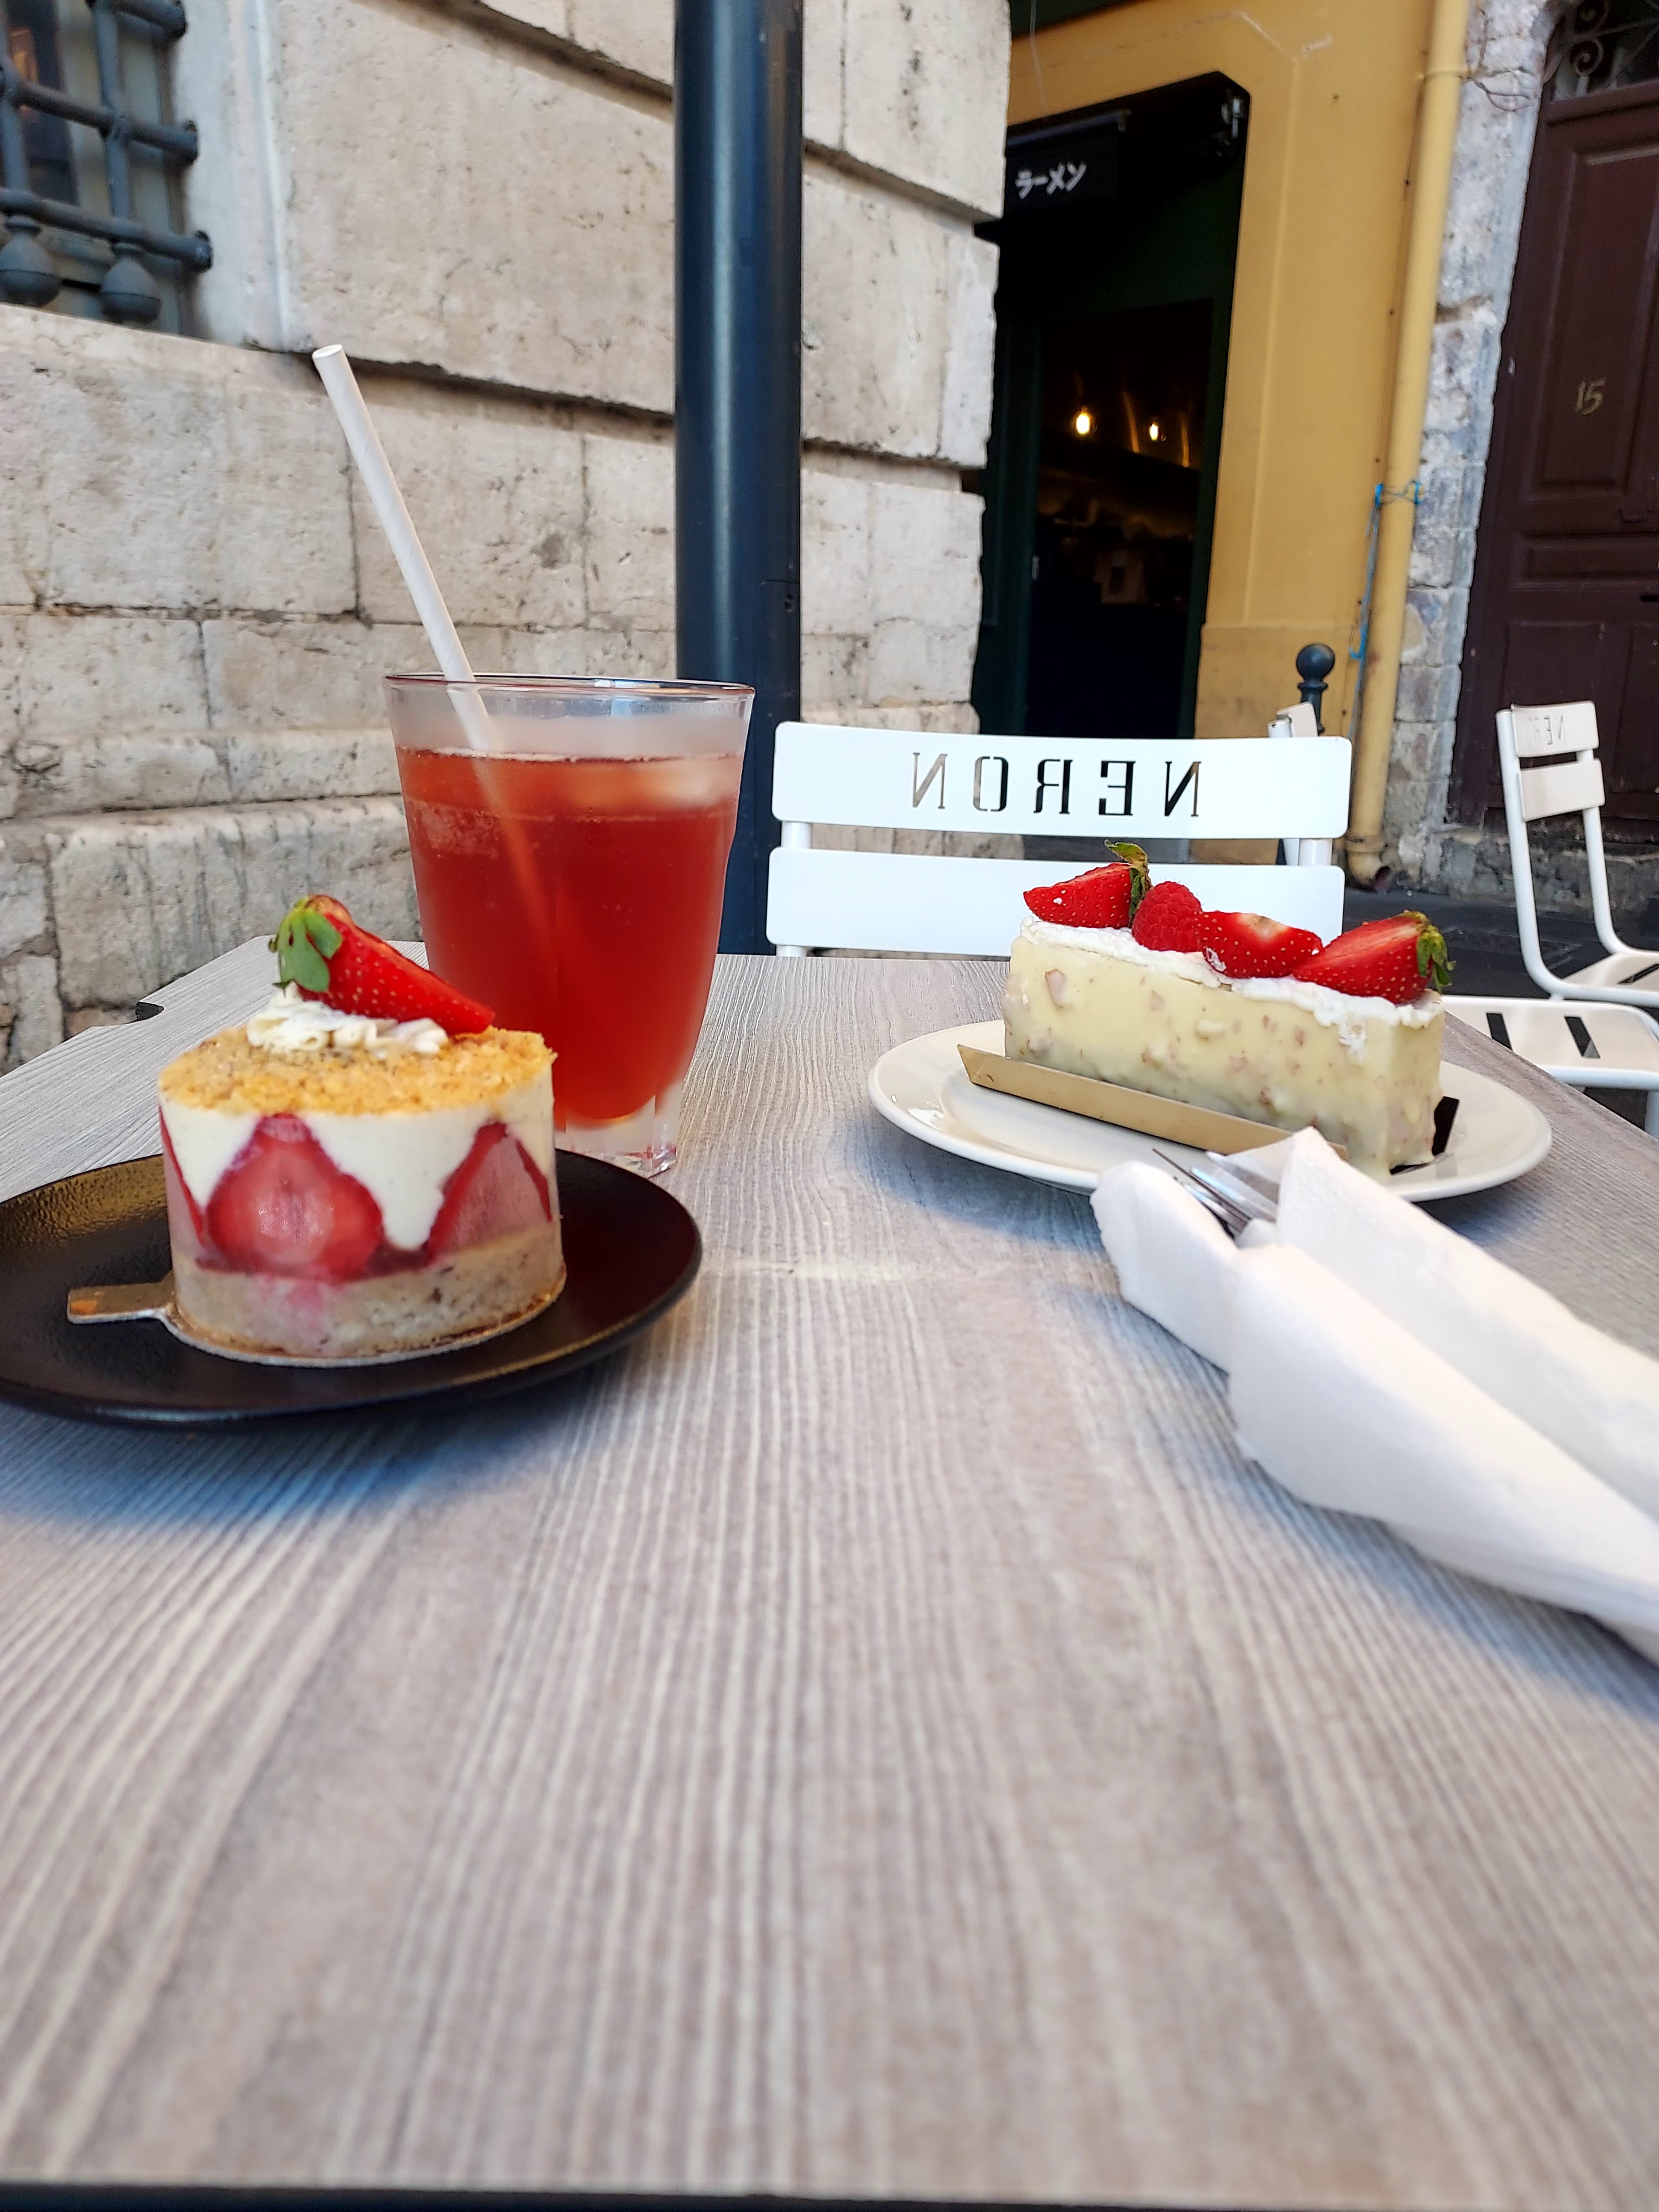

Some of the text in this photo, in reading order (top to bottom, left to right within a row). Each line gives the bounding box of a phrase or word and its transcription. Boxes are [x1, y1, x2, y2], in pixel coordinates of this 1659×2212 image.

[1015, 162, 1087, 199] ラーメン
[1575, 378, 1605, 415] 15
